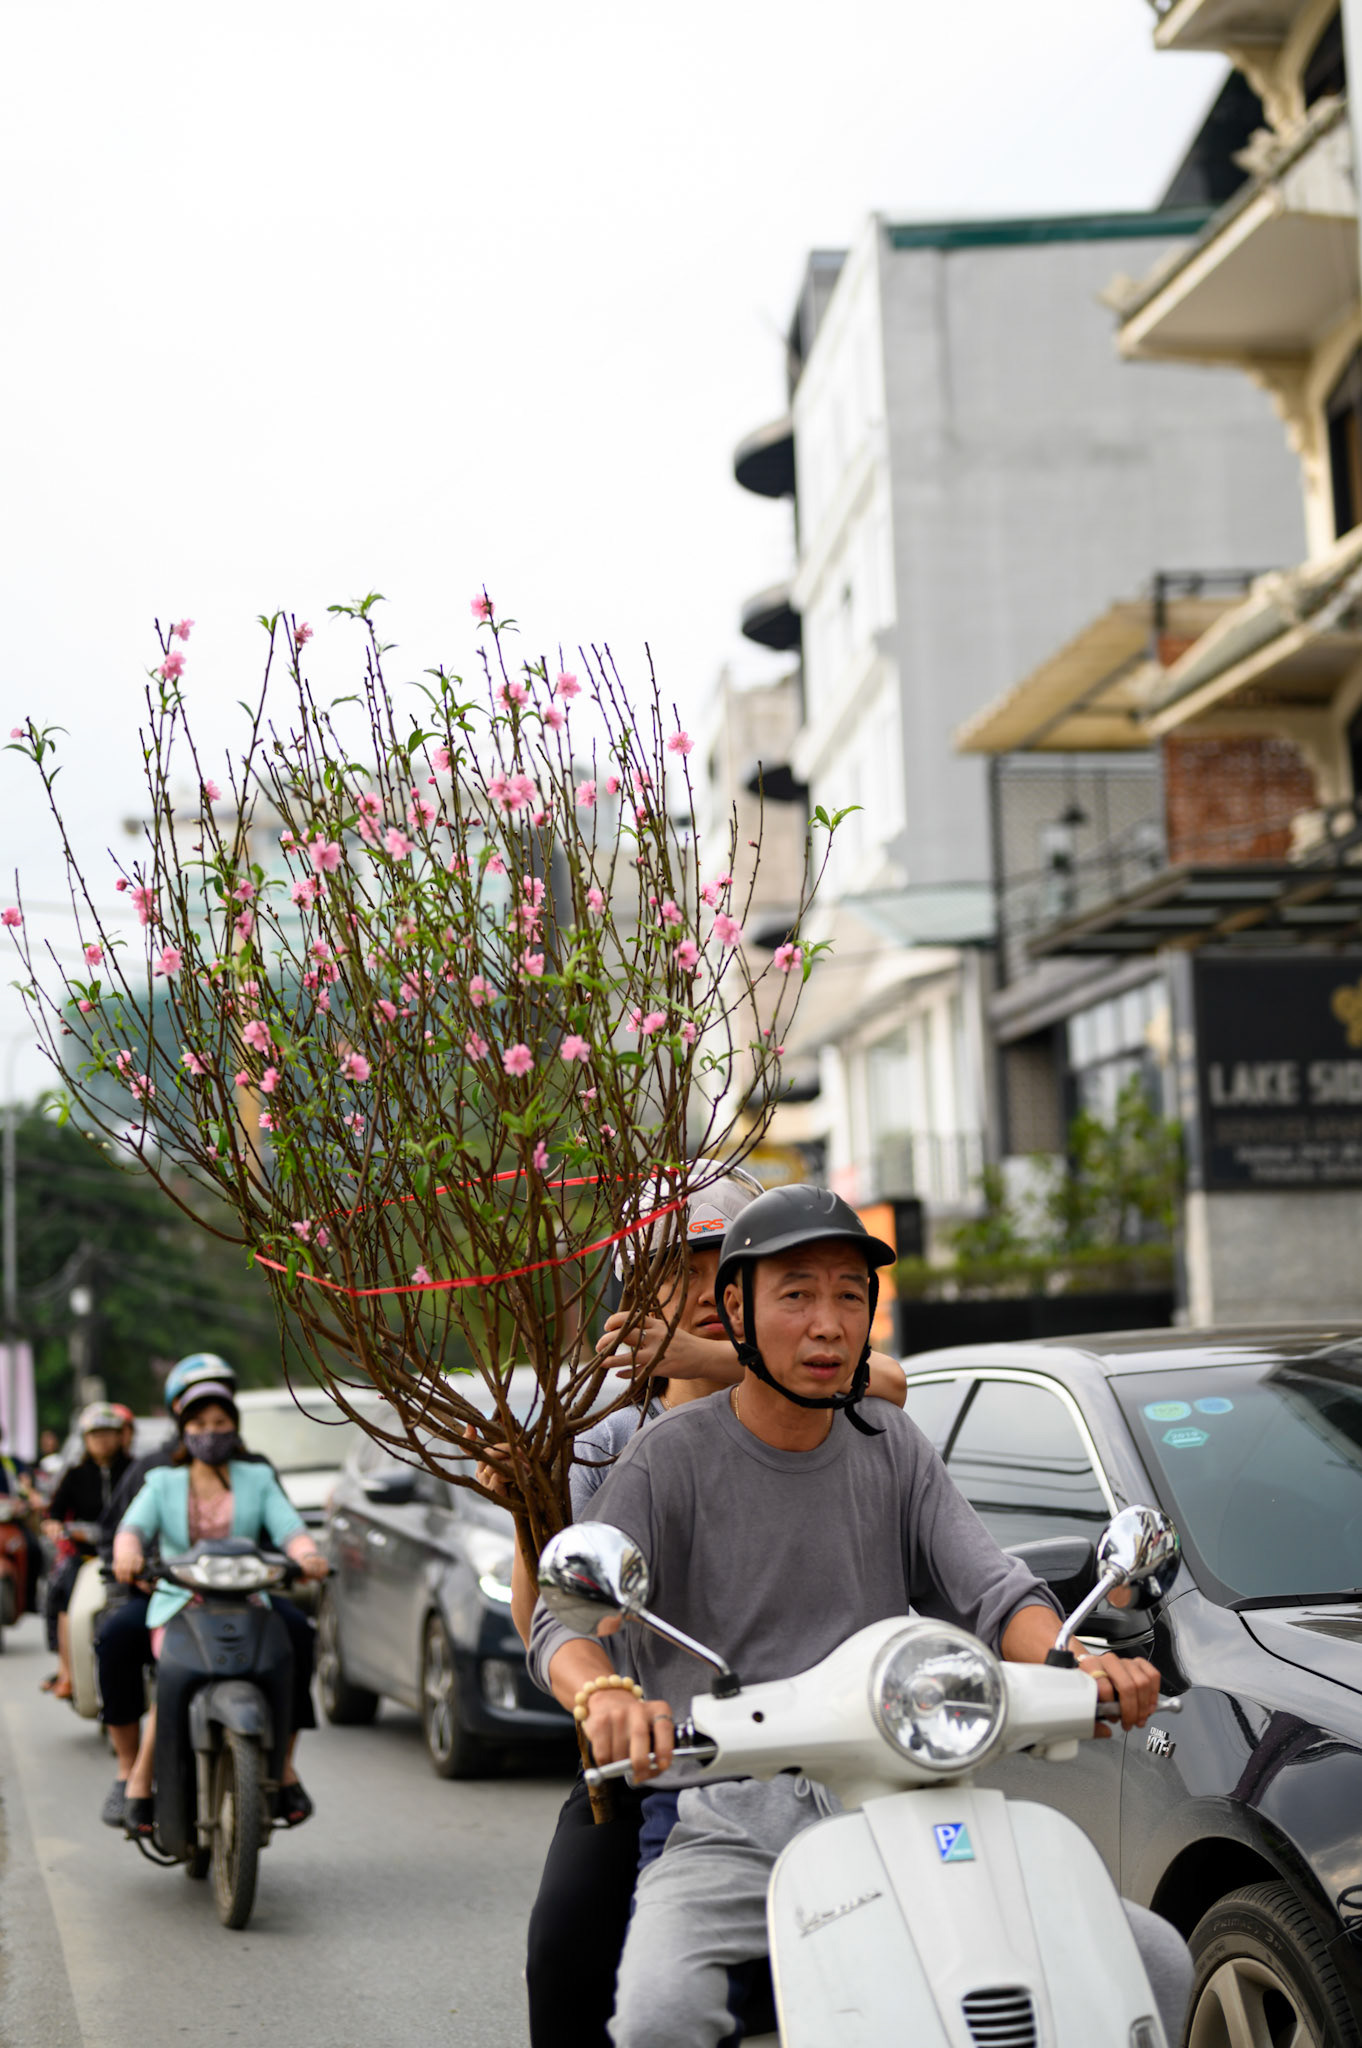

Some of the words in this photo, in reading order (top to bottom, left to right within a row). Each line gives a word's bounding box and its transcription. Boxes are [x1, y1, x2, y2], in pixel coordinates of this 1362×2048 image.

[1209, 1060, 1298, 1105] LAKE
[689, 1218, 724, 1233] GRS
[936, 1825, 956, 1850] P
